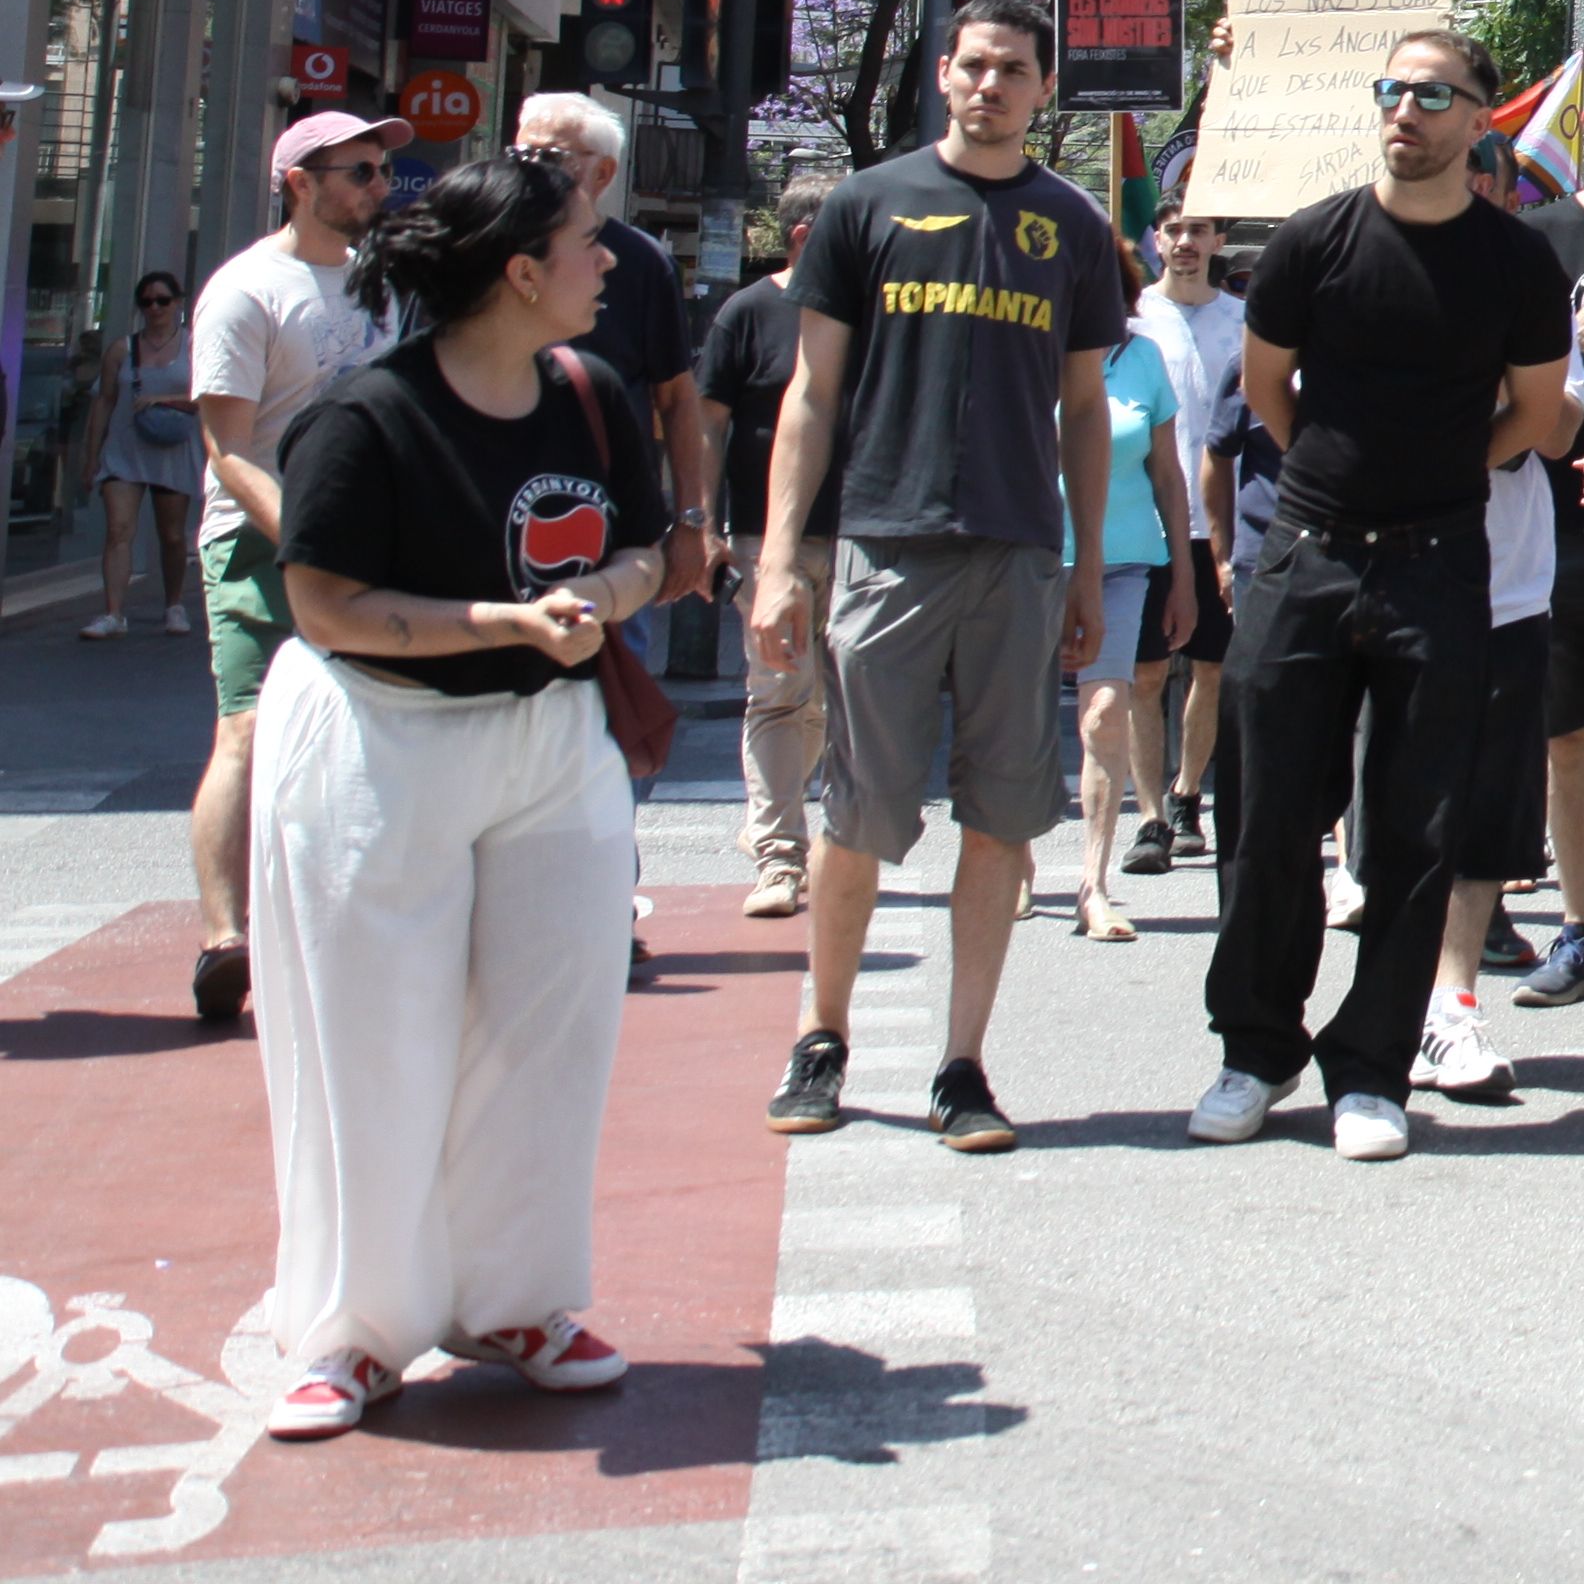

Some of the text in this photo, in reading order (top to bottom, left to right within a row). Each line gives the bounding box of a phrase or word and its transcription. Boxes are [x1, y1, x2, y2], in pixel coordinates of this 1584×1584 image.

[421, 0, 482, 16] VIATGES
[418, 23, 481, 36] CERDANYOLA
[1068, 49, 1089, 61] FORA
[1241, 30, 1256, 58] A
[299, 83, 342, 93] odafone
[411, 79, 470, 115] ria
[1229, 74, 1270, 100] QUE
[1222, 111, 1259, 140] NO
[883, 281, 1053, 332] TOPMANTA
